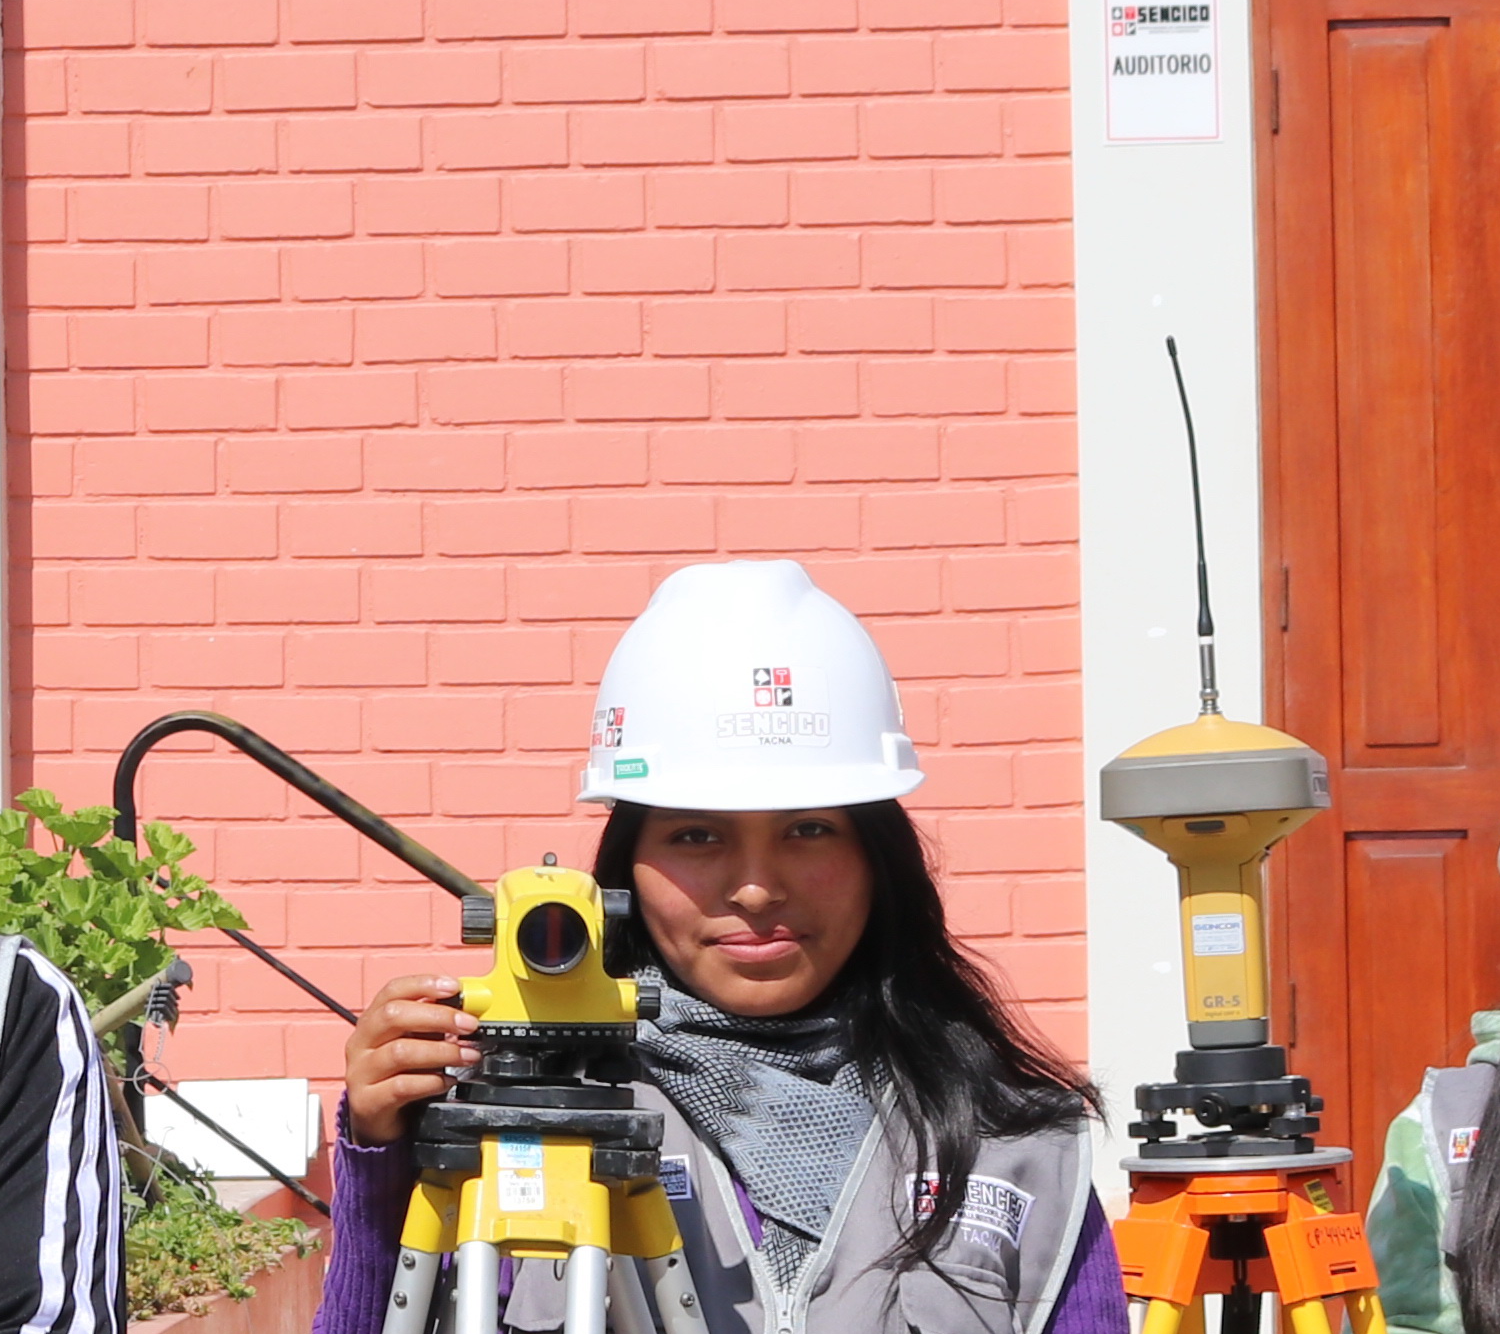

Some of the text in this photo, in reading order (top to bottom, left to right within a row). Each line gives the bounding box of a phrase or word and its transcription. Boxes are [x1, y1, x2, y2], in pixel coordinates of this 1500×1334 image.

[1137, 4, 1210, 23] SENCICO
[1112, 53, 1212, 76] AUDITORIO
[716, 711, 831, 738] SENCICO
[758, 736, 793, 745] TACNA
[1203, 995, 1241, 1009] GR-5
